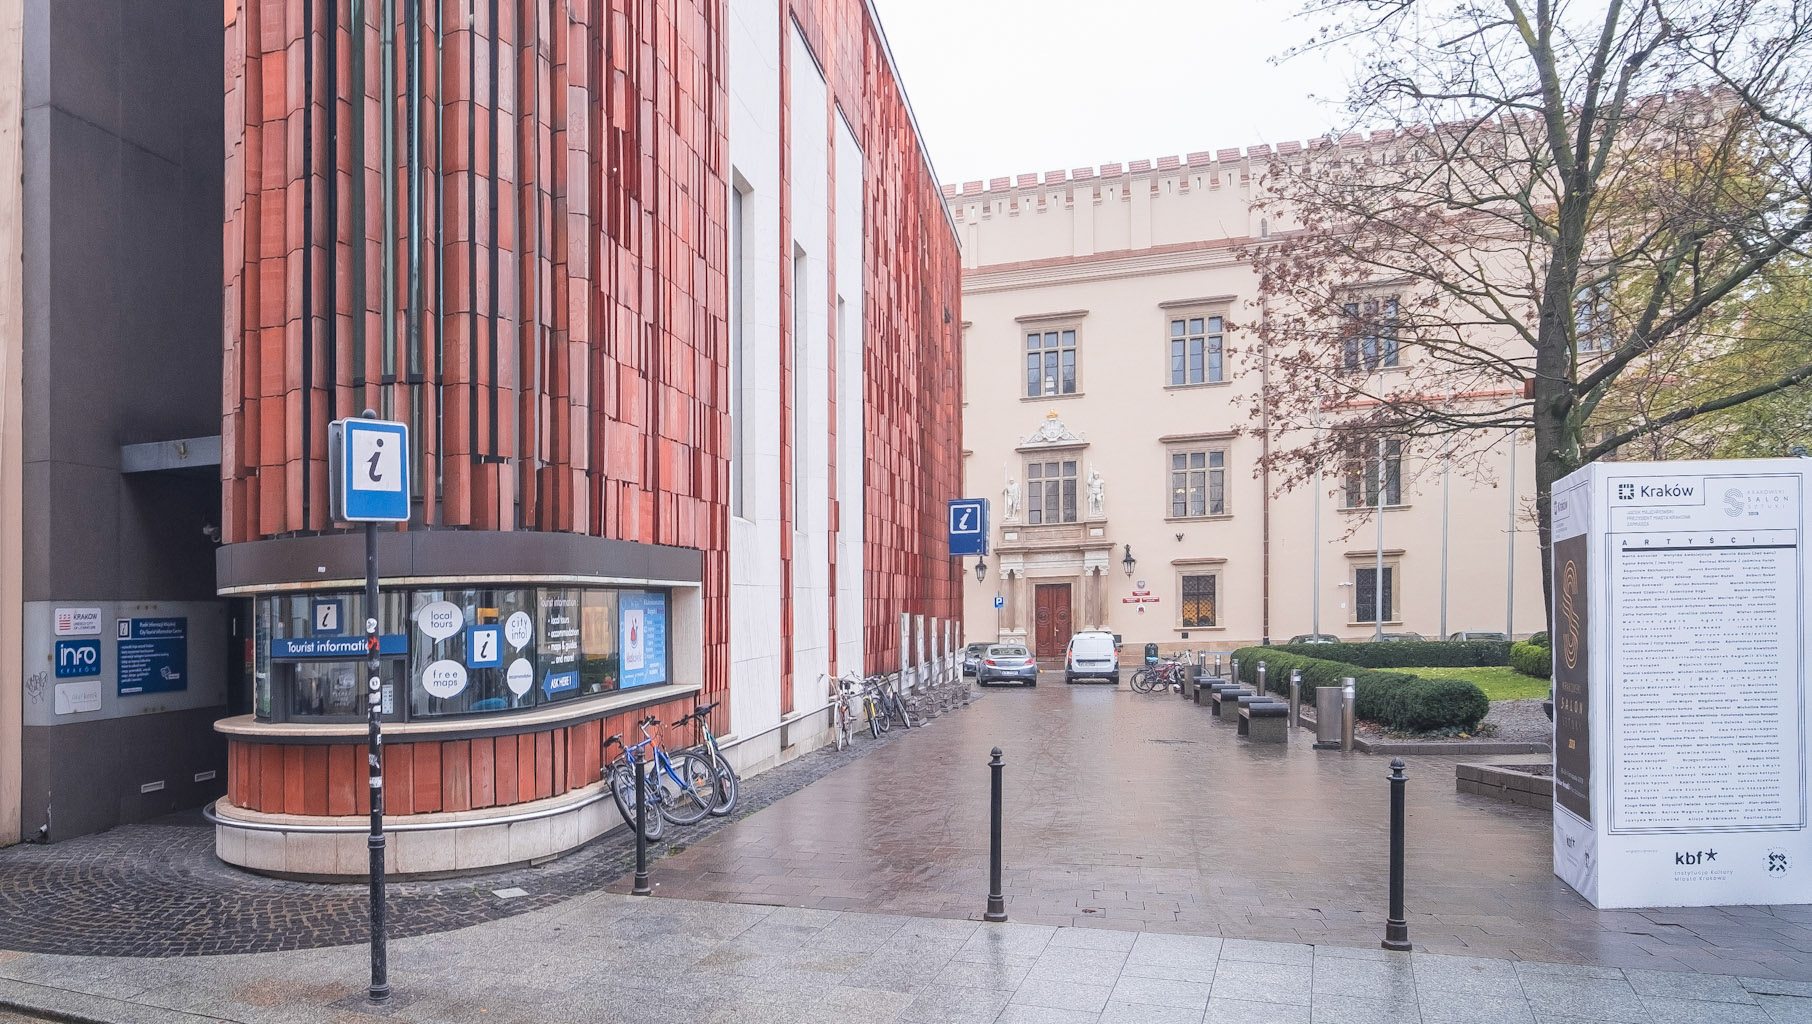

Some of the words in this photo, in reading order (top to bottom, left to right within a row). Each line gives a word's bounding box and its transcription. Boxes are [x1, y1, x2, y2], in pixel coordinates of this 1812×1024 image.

[1640, 484, 1694, 498] Kraków
[1747, 495, 1789, 503] SALON
[430, 610, 452, 620] local
[430, 620, 453, 628] tours
[511, 616, 528, 630] city
[287, 641, 314, 653] Tourist
[433, 669, 458, 679] free
[433, 679, 458, 688] maps
[550, 678, 559, 689] ASK
[1560, 696, 1583, 714] SALON
